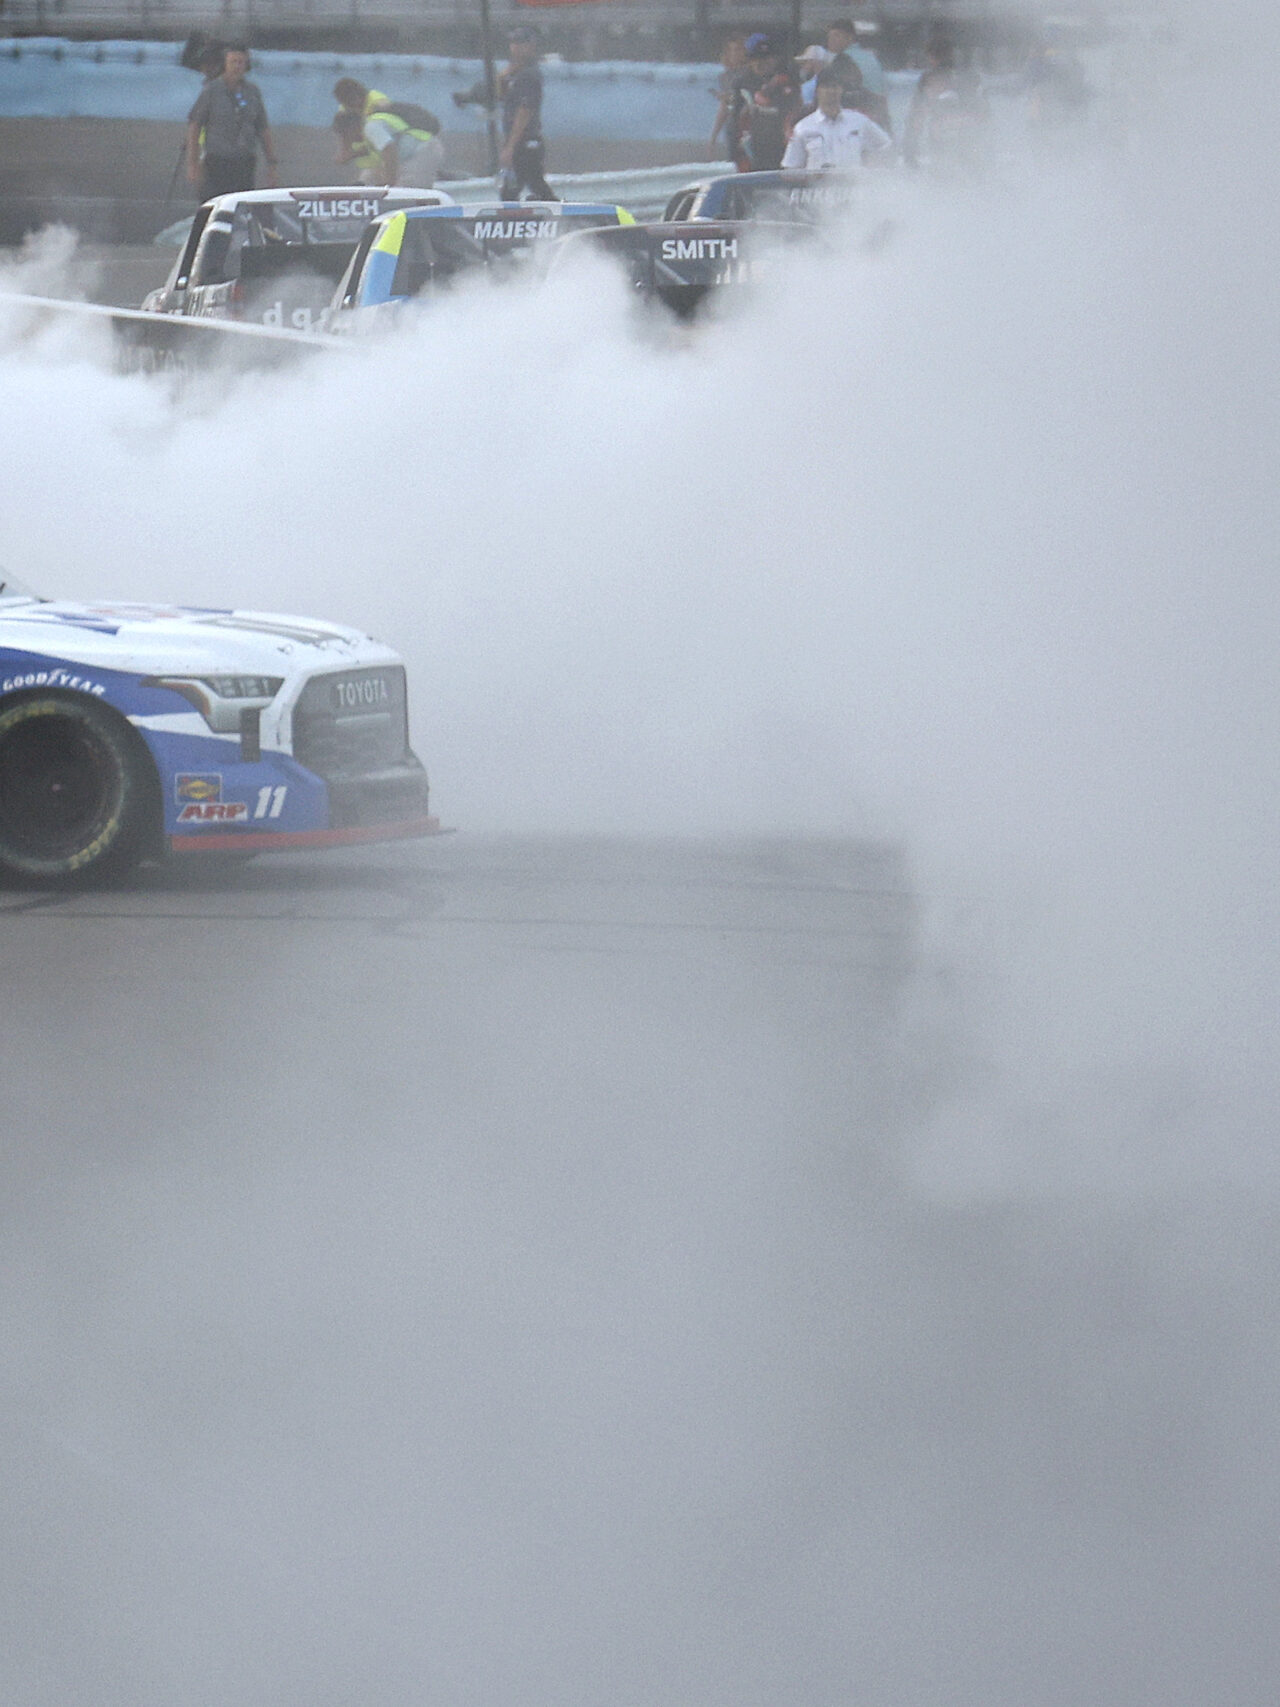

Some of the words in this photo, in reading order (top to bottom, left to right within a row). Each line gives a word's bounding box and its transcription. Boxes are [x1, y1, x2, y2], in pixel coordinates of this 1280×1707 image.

[298, 200, 379, 218] ZILISCH
[474, 221, 558, 239] MAJESKI
[661, 239, 738, 260] SMITH
[336, 679, 388, 706] TOYOTA
[179, 802, 247, 821] ARP
[254, 785, 288, 819] 11
